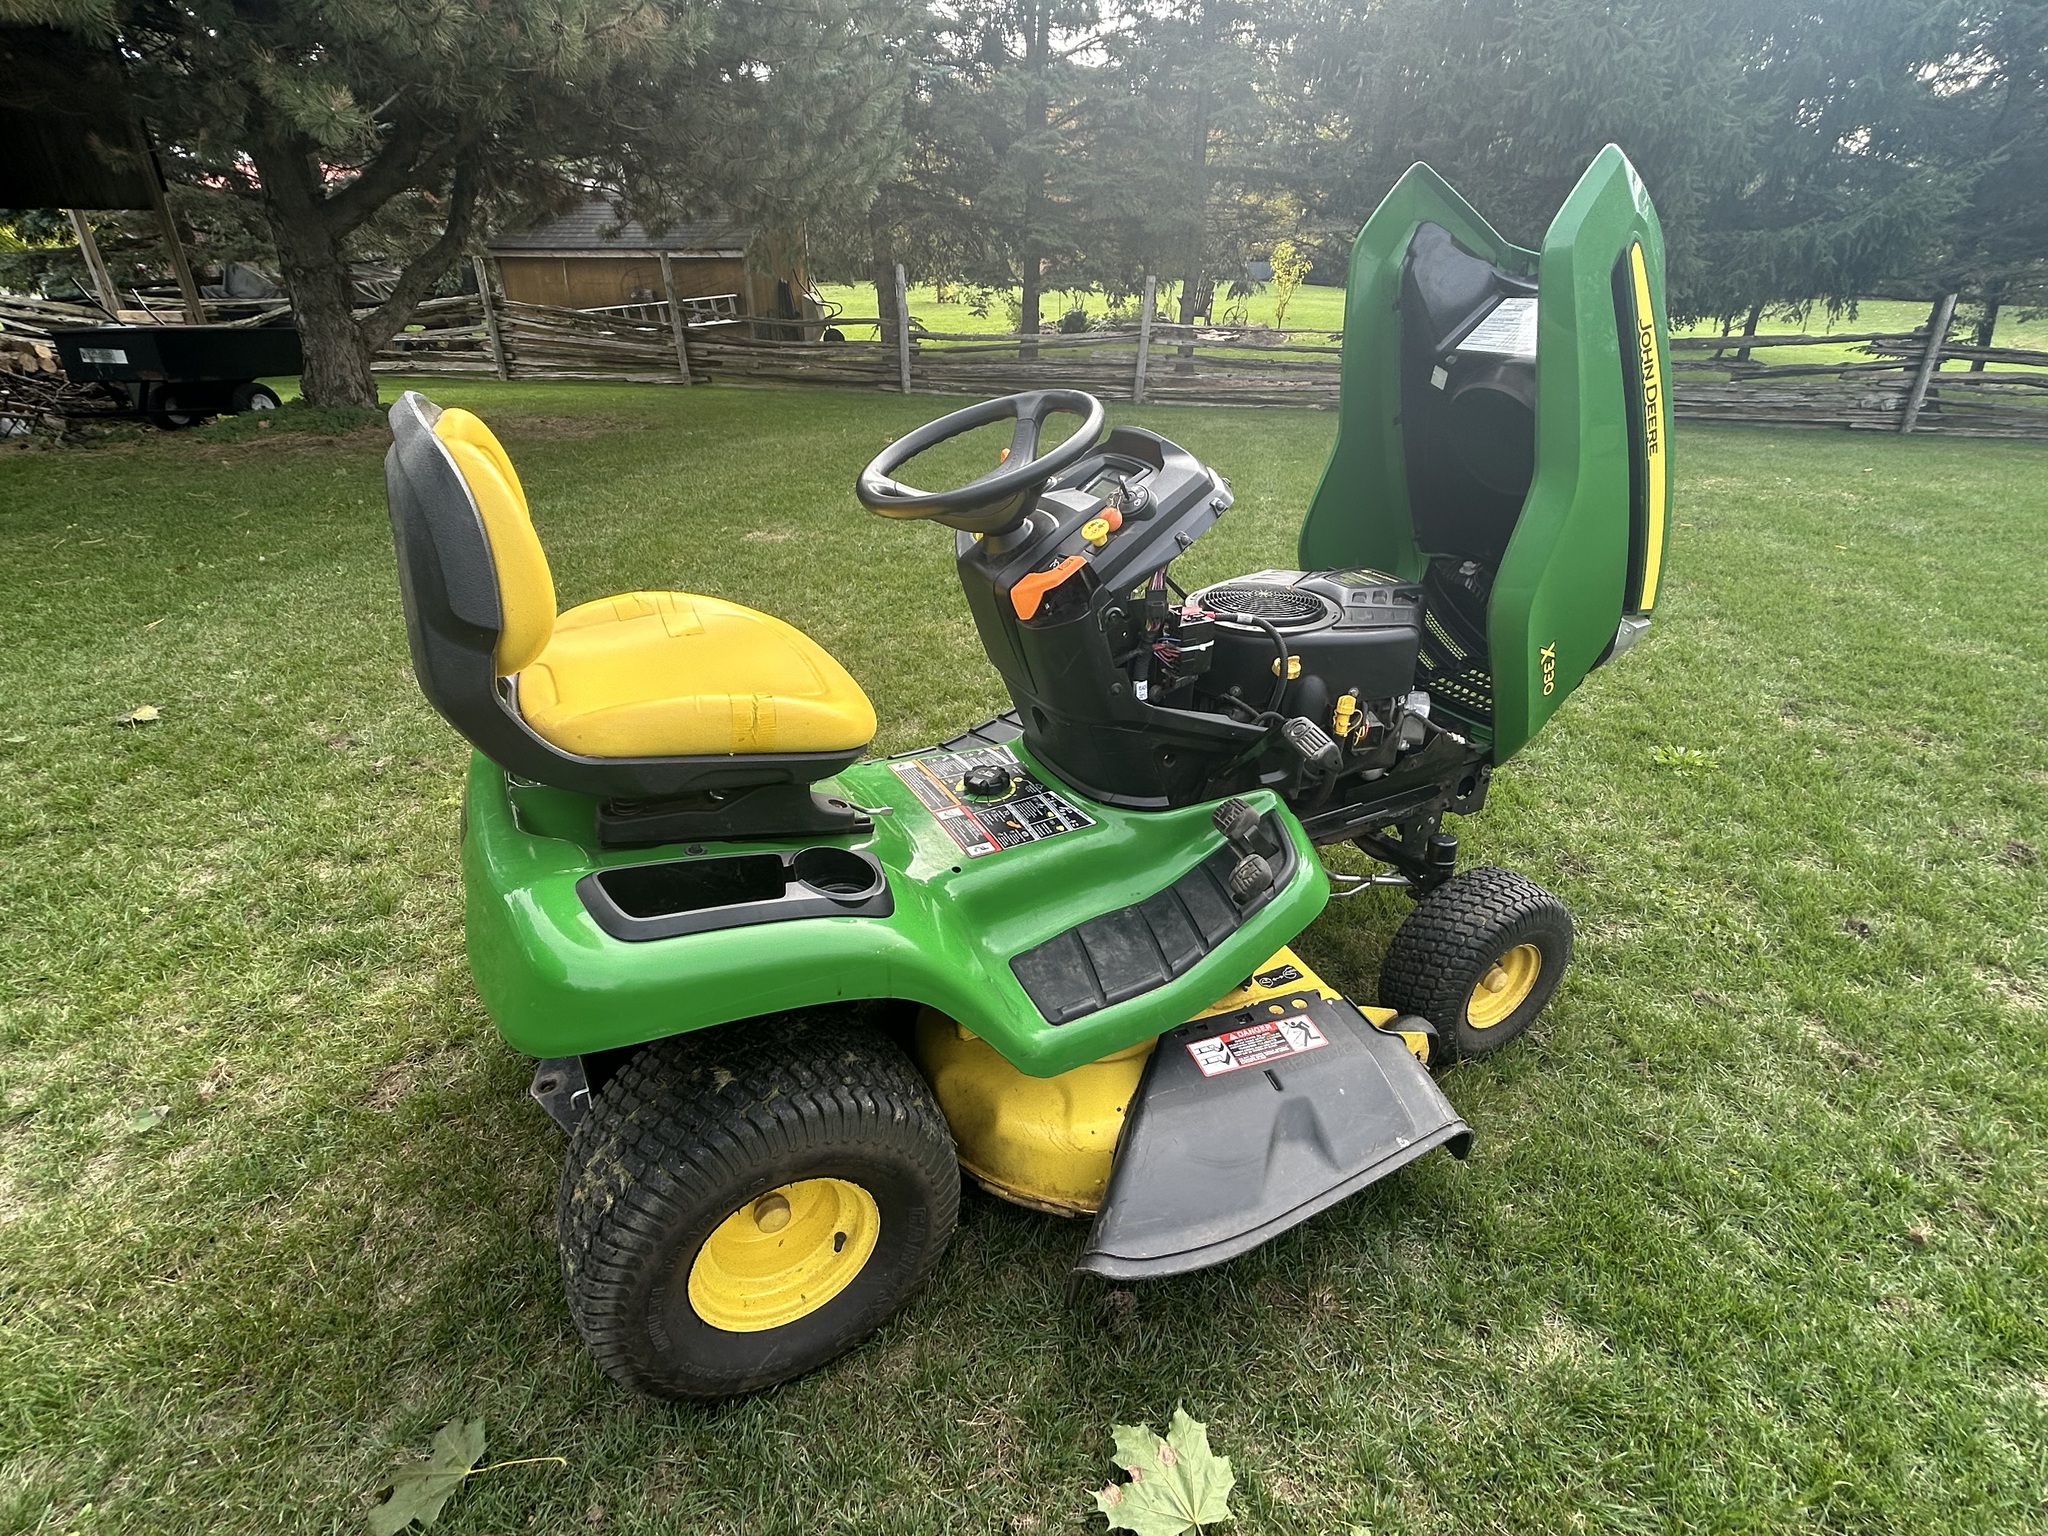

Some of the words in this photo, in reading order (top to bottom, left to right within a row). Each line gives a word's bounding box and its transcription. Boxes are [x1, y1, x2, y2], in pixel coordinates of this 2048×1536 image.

[1639, 319, 1654, 382] JOHN
[1645, 383, 1658, 457] DEERE
[1540, 640, 1555, 696] X330
[1236, 1023, 1273, 1039] DANGER
[654, 1213, 714, 1274] TRAC
[831, 1206, 927, 1348] CARLISLE
